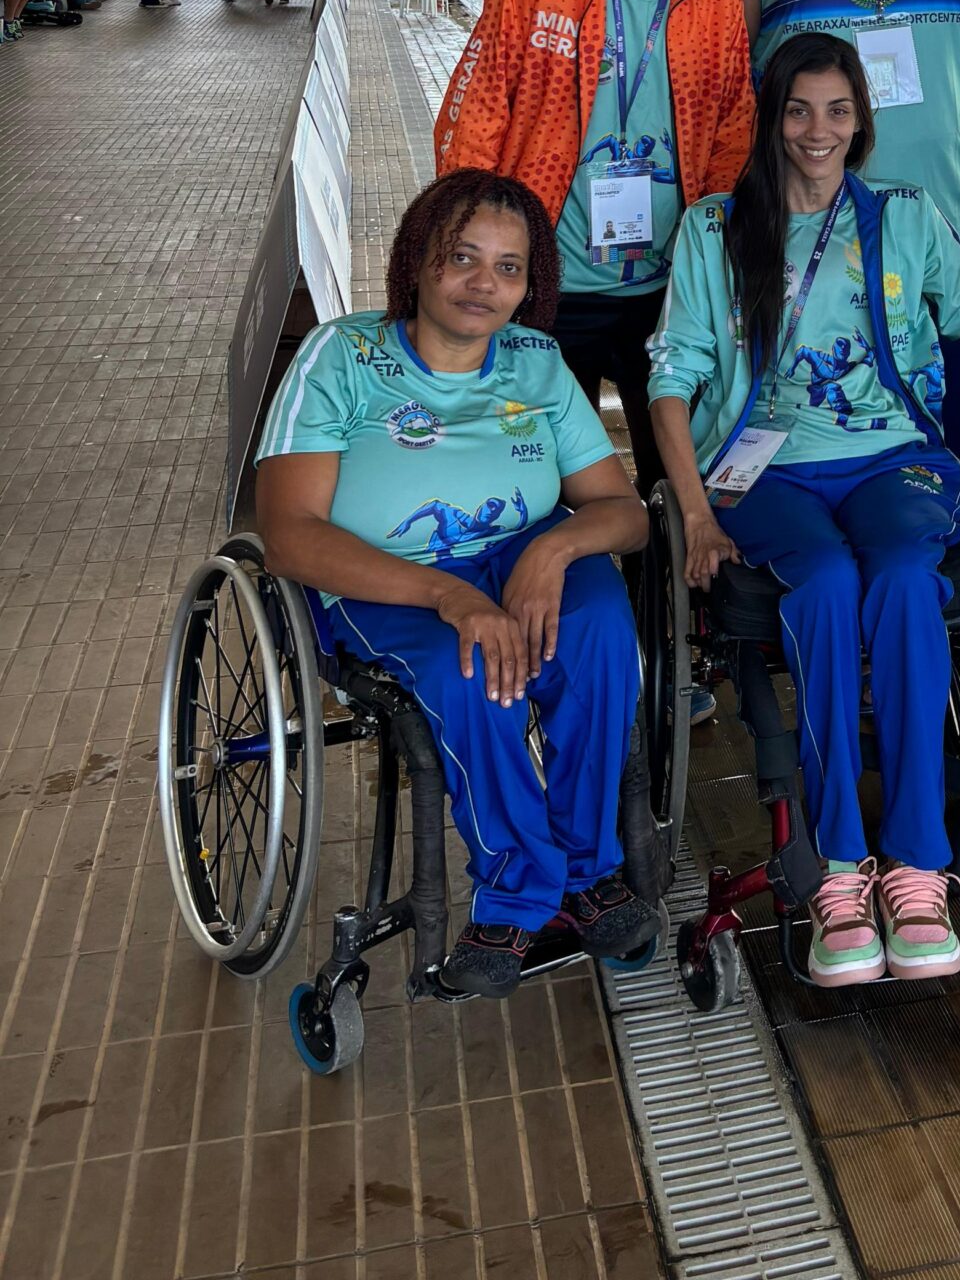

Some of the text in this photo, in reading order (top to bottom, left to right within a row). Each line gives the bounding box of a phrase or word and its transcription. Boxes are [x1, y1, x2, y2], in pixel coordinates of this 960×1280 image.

[448, 37, 483, 123] GERAIS
[850, 293, 868, 305] AP
[500, 336, 559, 351] MECTEK
[891, 332, 910, 347] PAE
[511, 443, 545, 457] APAE
